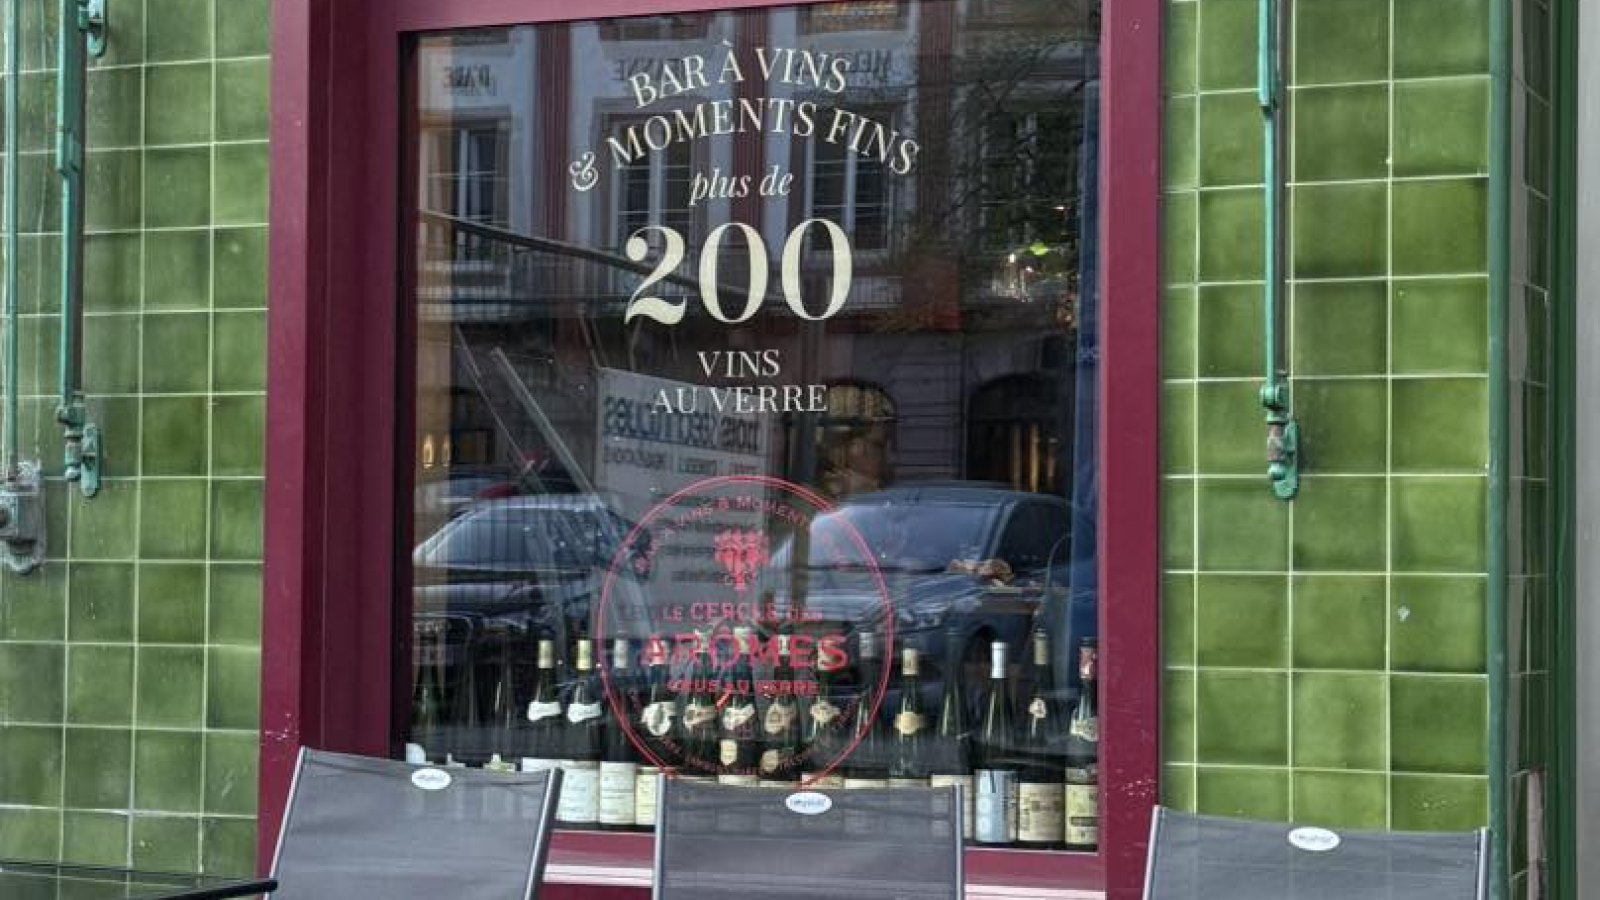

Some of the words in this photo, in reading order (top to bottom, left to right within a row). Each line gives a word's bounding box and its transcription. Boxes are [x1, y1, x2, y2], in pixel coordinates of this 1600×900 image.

[629, 54, 709, 109] BAR
[718, 40, 744, 83] À
[755, 47, 851, 93] VINS
[569, 151, 599, 192] &
[606, 98, 817, 168] MOMENTS
[825, 108, 920, 175] FINS
[689, 167, 751, 206] plus
[759, 165, 794, 197] de
[623, 218, 852, 325] 200
[697, 348, 781, 378] VINS
[651, 387, 697, 414] AU
[709, 383, 828, 413] VERRE
[641, 617, 849, 671] ARÔMES
